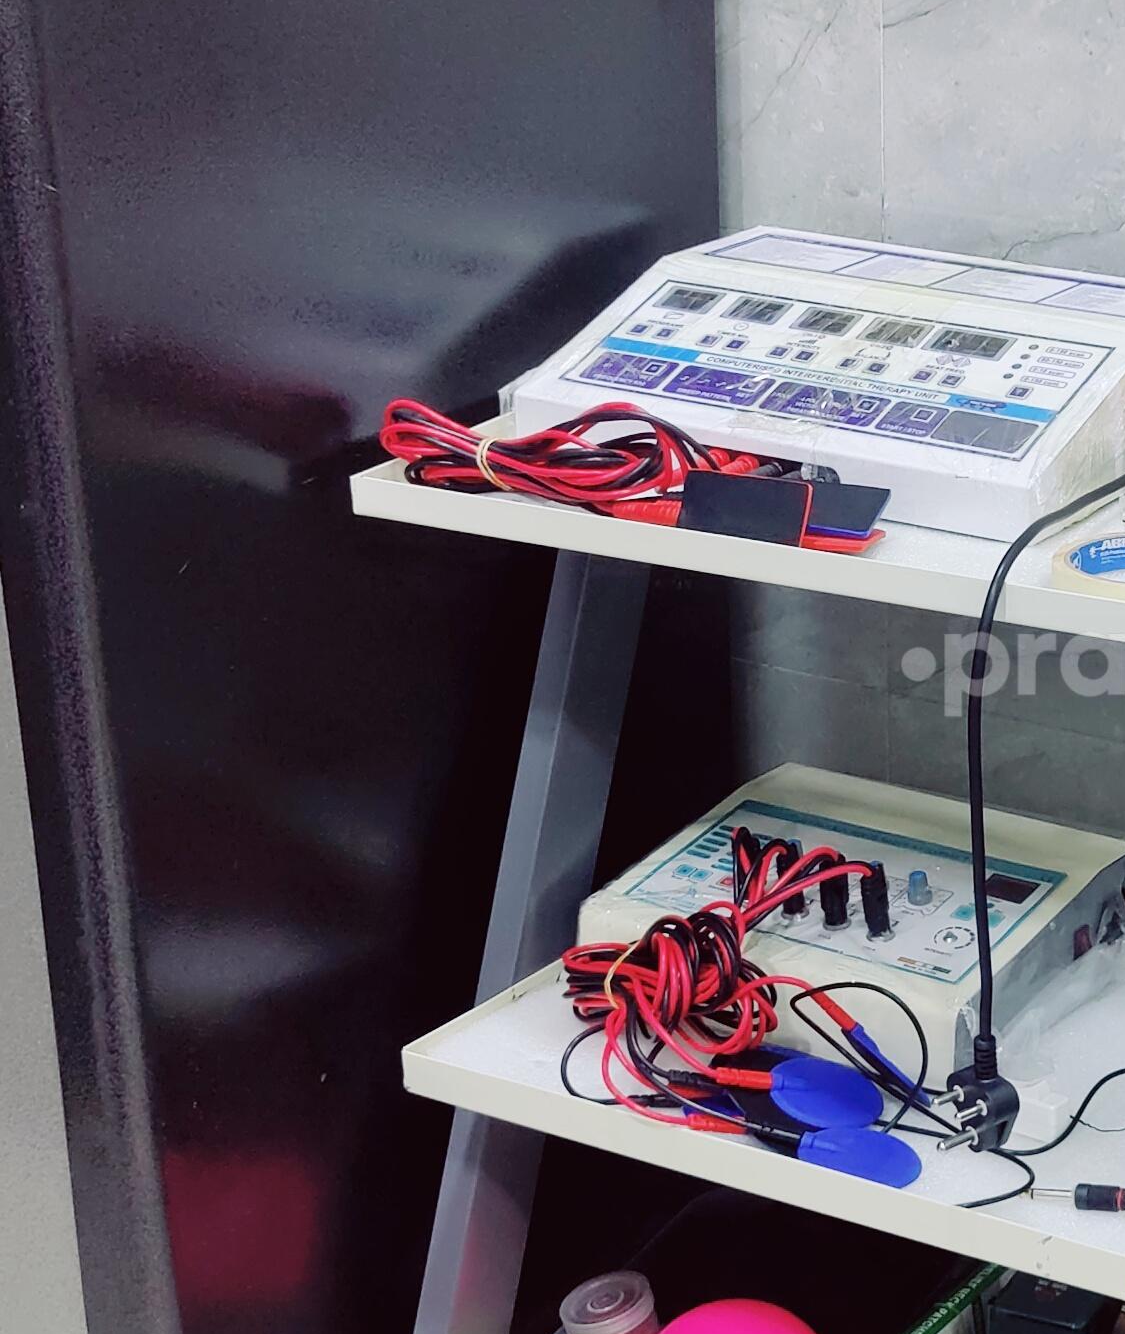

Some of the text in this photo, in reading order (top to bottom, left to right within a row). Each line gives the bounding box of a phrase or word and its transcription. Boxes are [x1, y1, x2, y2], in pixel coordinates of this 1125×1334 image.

[704, 355, 784, 373] COMPUTERISD
[864, 382, 915, 395] THERAPY
[912, 390, 940, 400] UNIT
